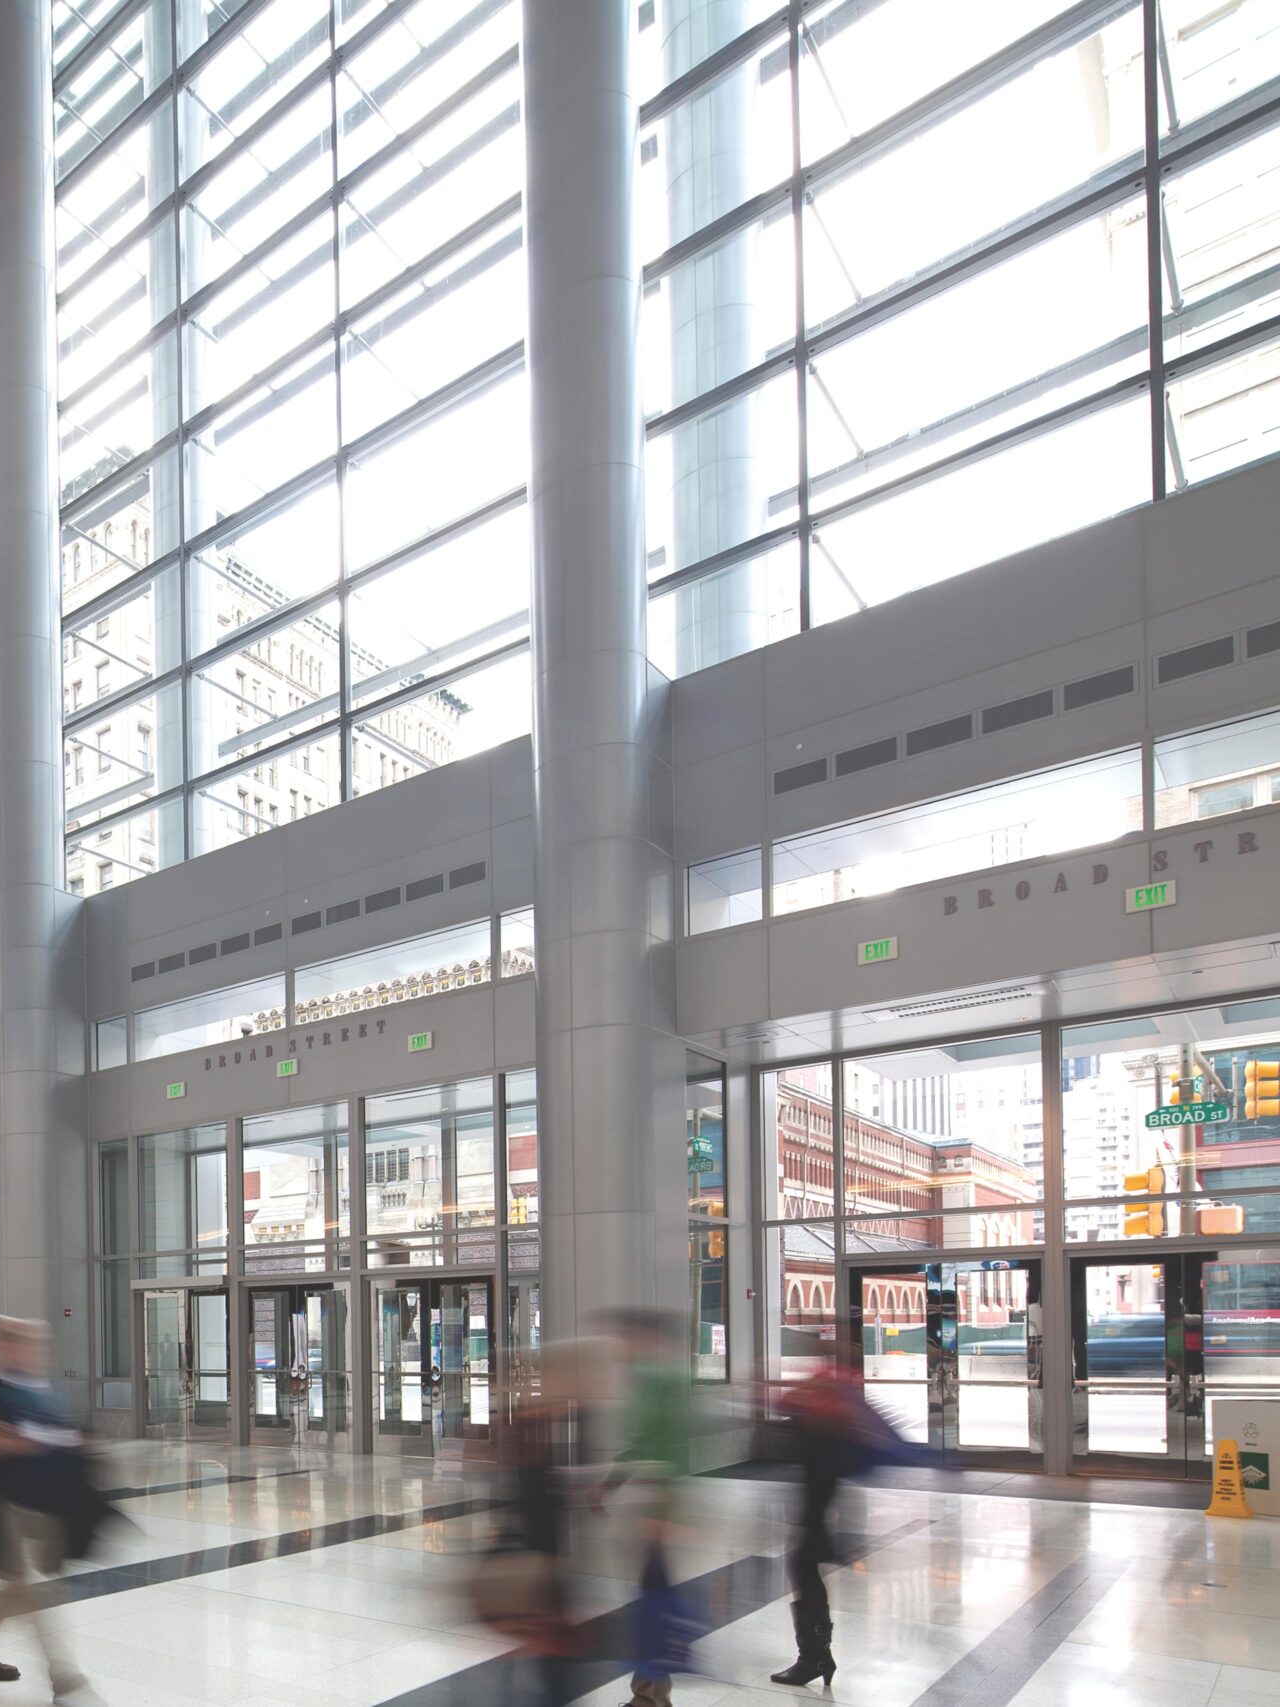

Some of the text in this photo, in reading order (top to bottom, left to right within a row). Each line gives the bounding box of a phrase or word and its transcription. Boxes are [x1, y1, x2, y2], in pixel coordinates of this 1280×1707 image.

[943, 832, 1259, 916] BROAD STR
[1135, 884, 1168, 909] EXIT
[864, 940, 891, 961] EXIT
[204, 1020, 386, 1071] BROAD STREET
[412, 1034, 428, 1049] EXIT
[1149, 1110, 1224, 1126] BROAD ST
